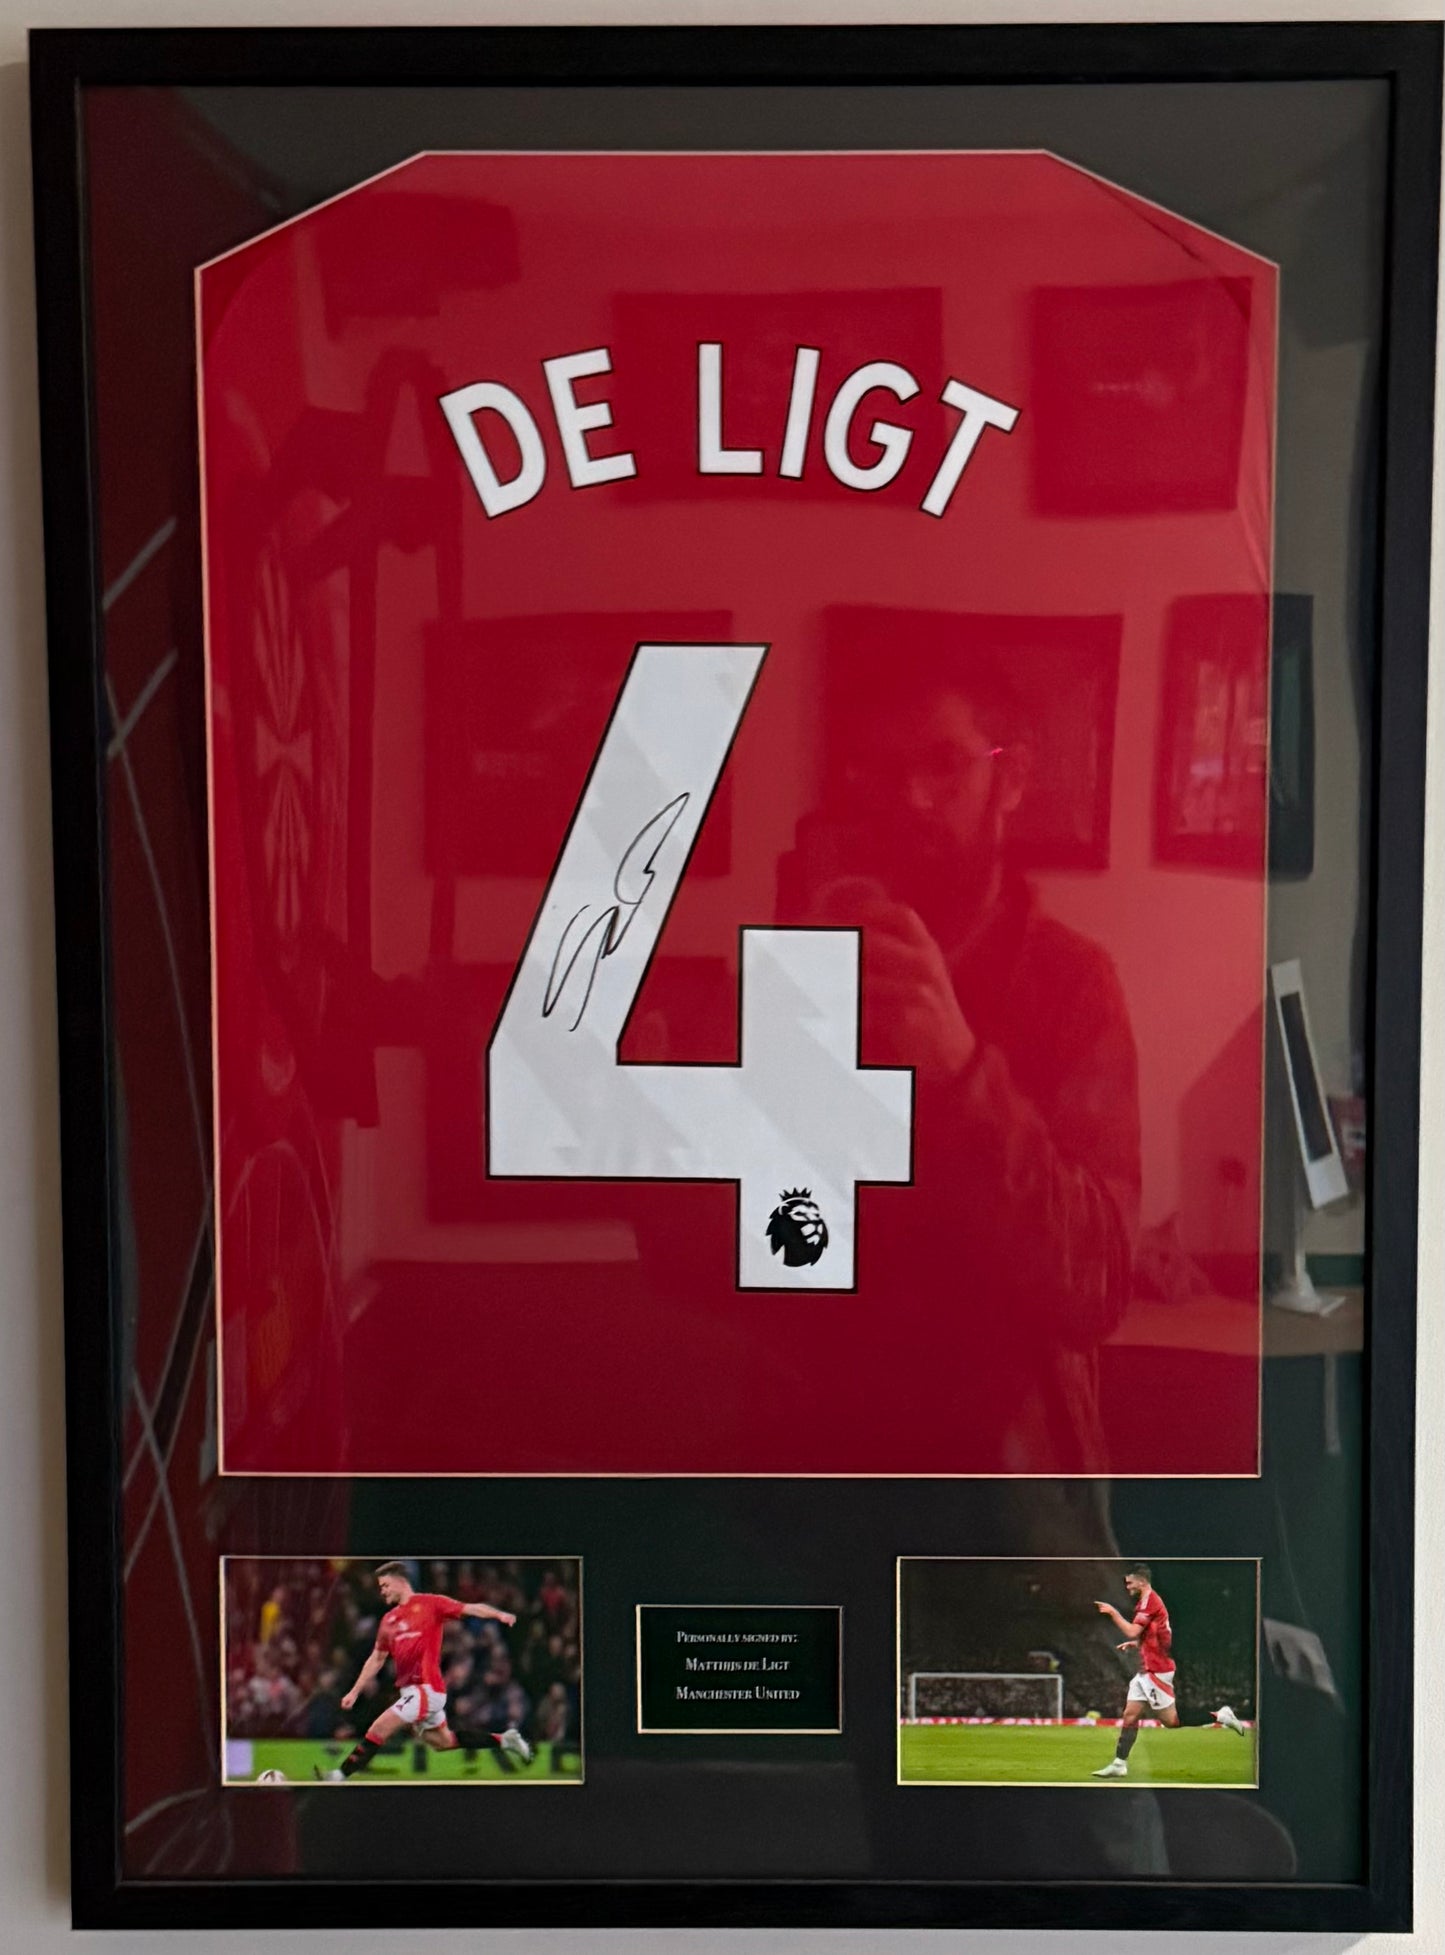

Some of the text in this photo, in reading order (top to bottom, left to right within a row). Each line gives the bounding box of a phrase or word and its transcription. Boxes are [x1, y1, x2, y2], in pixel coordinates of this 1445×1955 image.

[438, 341, 1023, 519] DE LIGT
[485, 641, 916, 1293] 4
